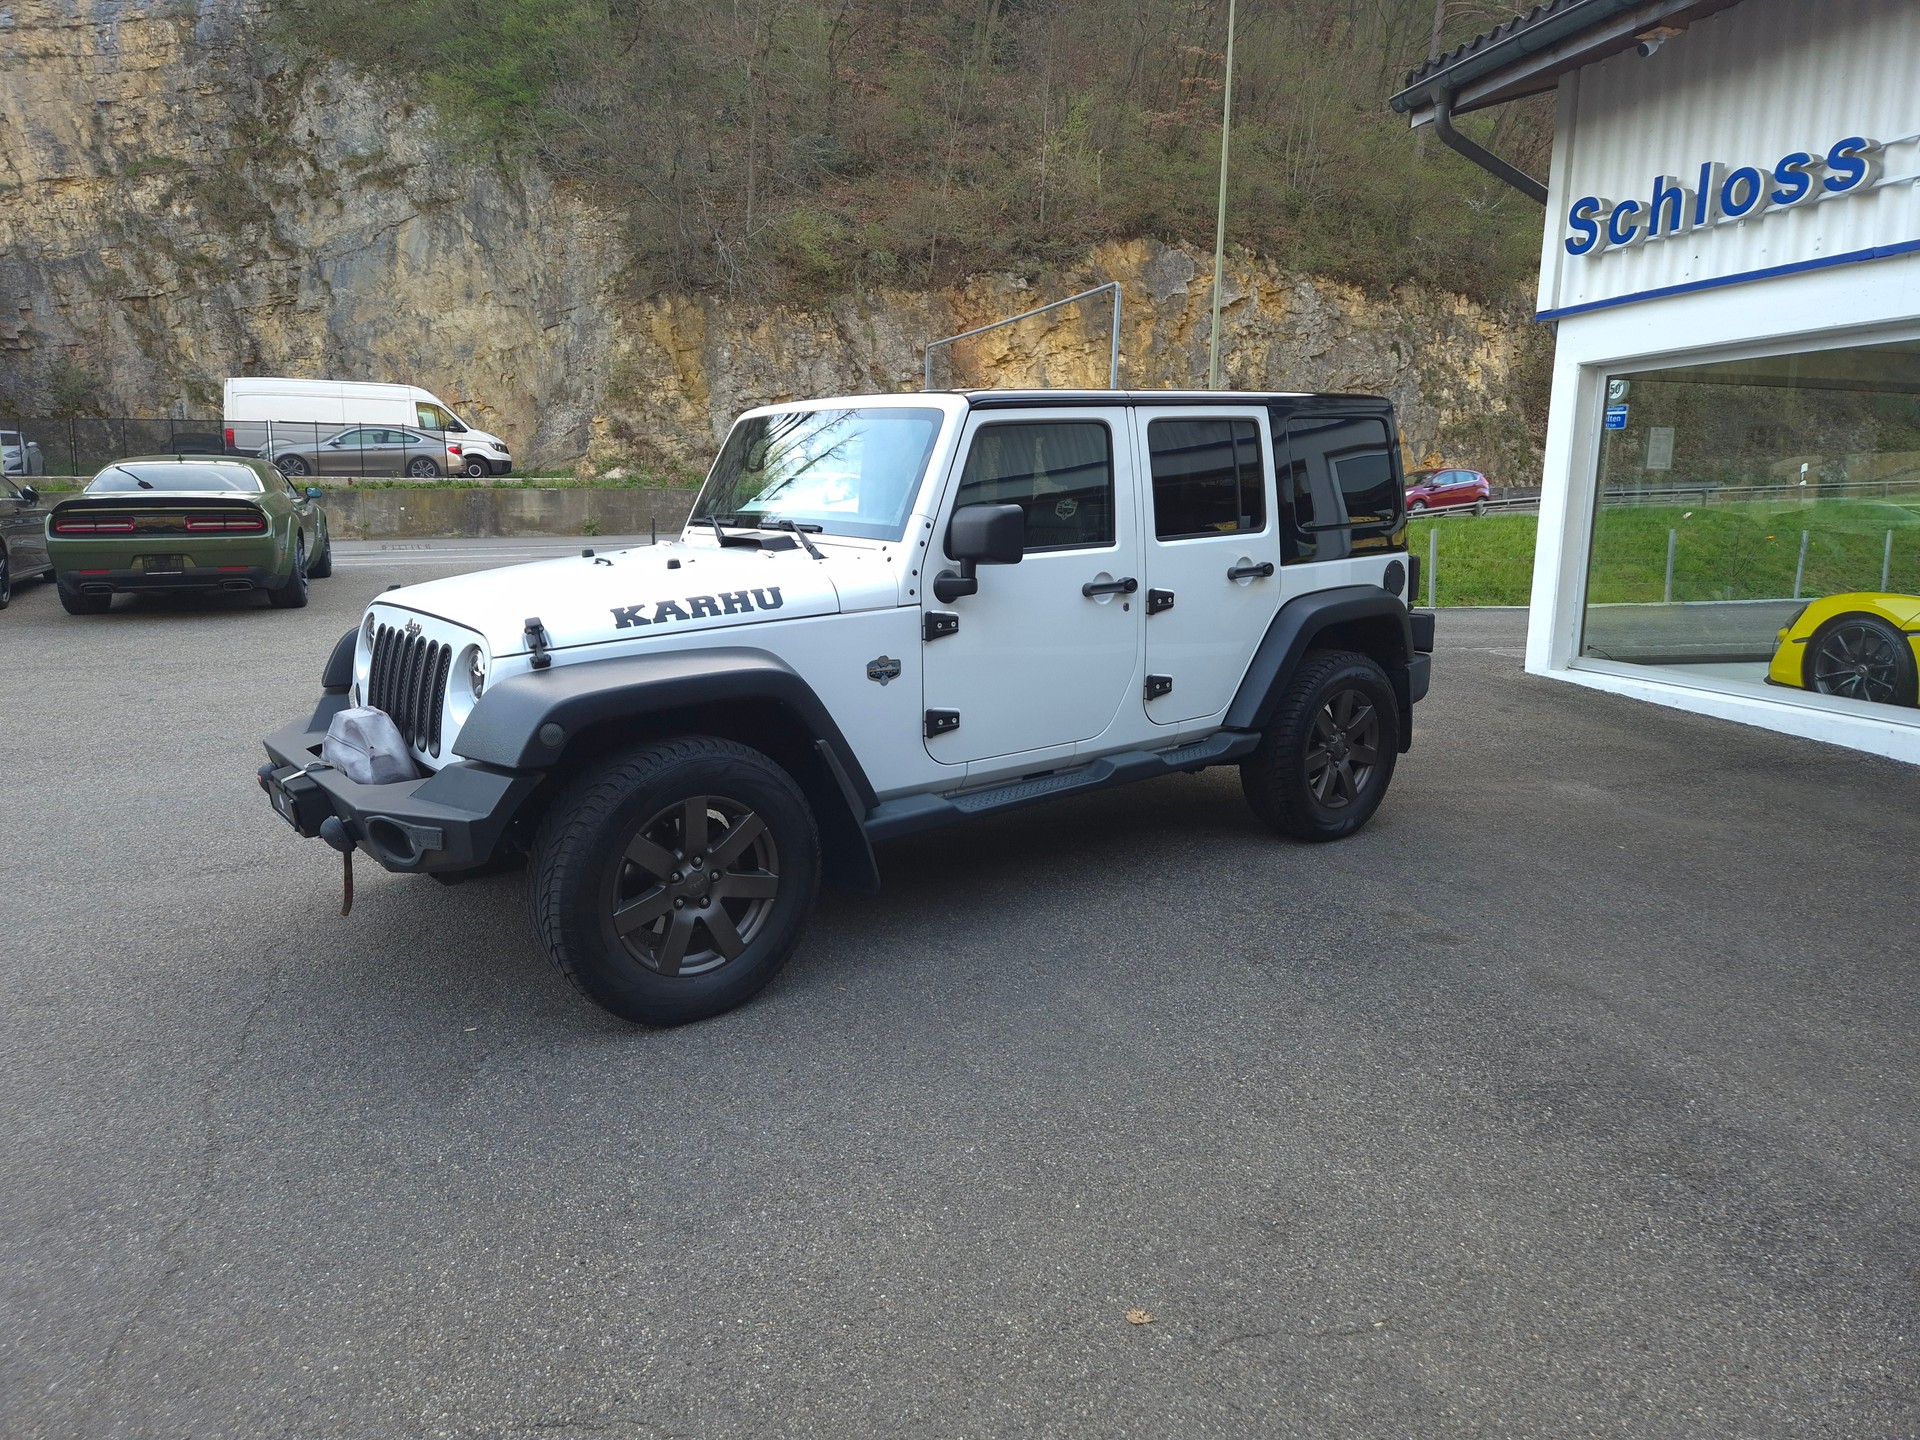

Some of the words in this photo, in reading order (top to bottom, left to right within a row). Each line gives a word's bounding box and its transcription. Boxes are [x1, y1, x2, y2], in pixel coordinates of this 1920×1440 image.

[1564, 136, 1880, 256] Schloss
[1609, 383, 1621, 395] 50
[1605, 415, 1621, 423] lten
[610, 586, 785, 629] KARHU
